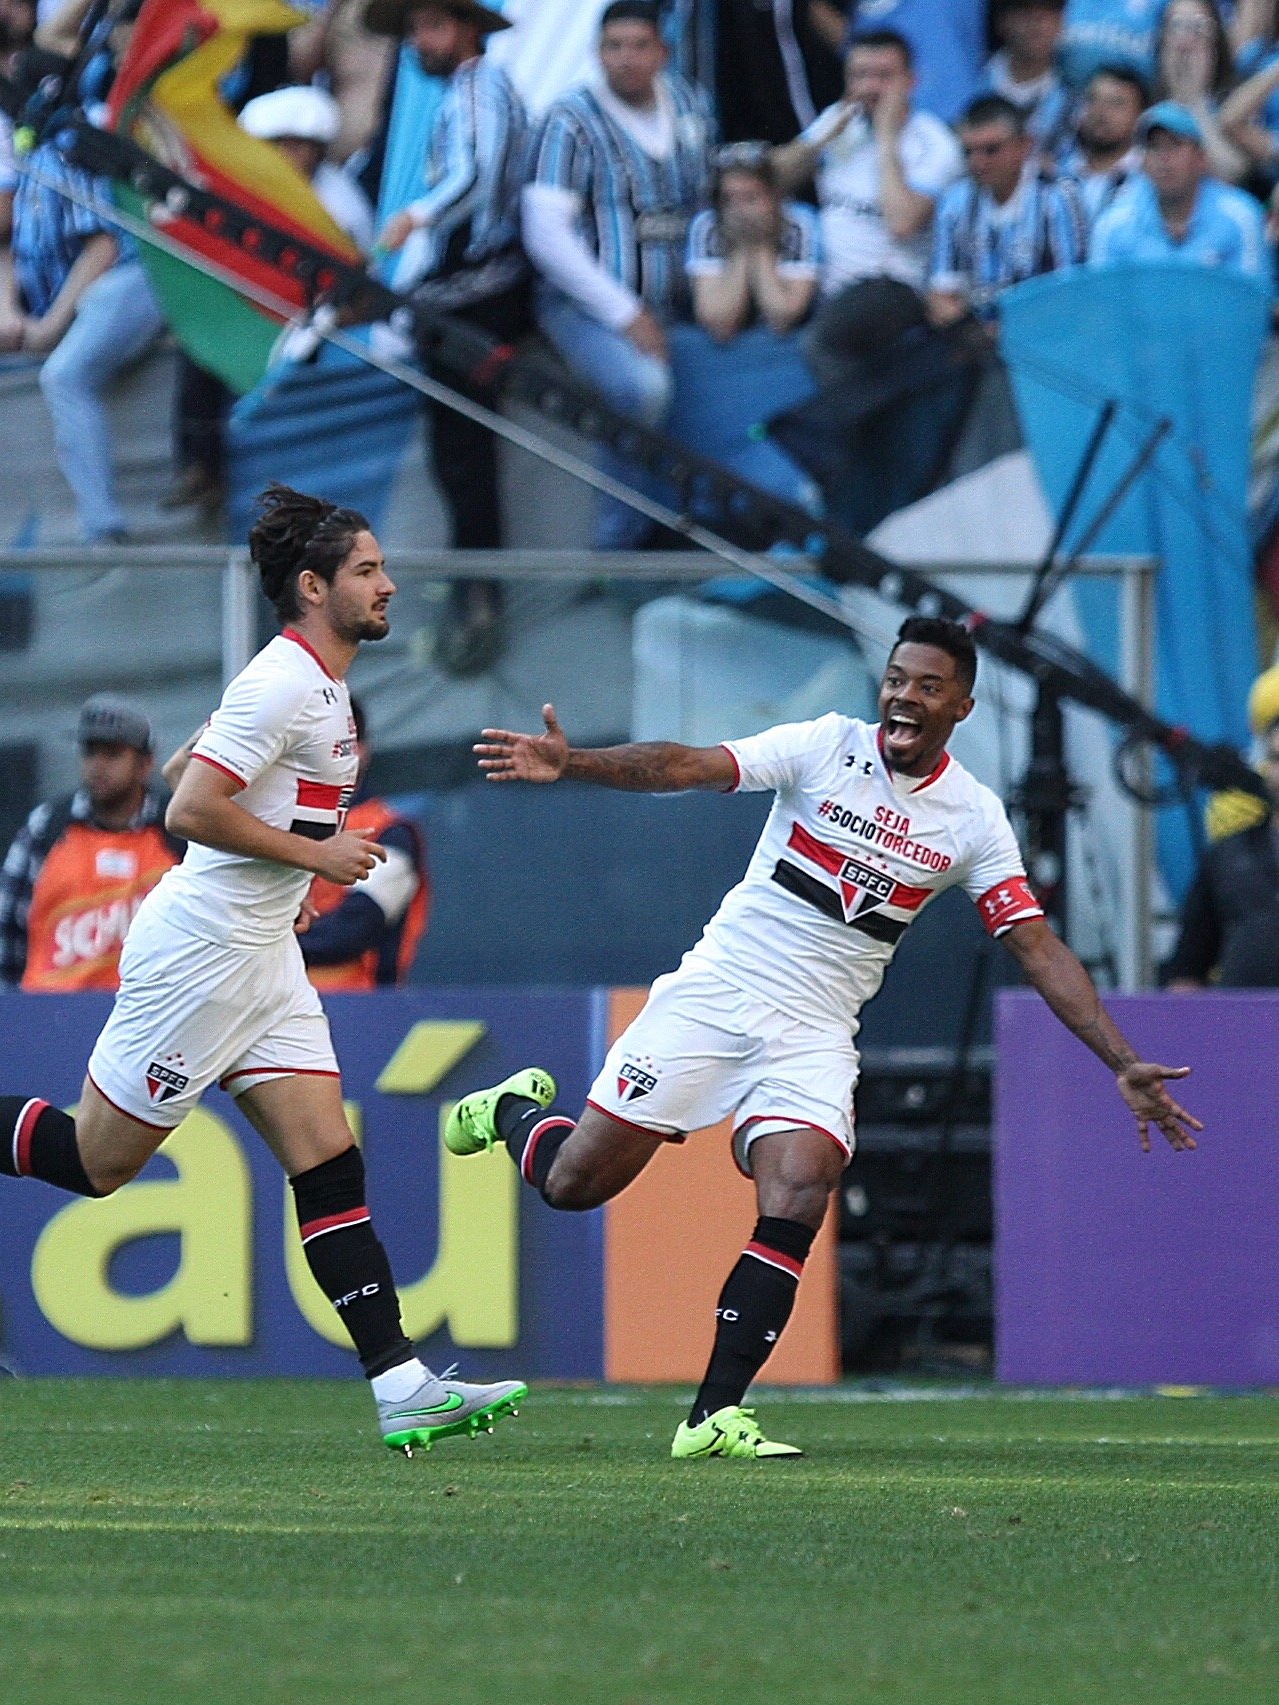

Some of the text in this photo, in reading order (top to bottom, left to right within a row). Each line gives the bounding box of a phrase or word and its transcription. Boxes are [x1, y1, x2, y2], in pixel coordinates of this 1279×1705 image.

[817, 799, 953, 873] #SOCIOTORCEDOR
[873, 805, 911, 836] SEJA
[844, 865, 893, 897] SPFC
[150, 1065, 186, 1089] SPFC
[620, 1065, 655, 1089] SPFC
